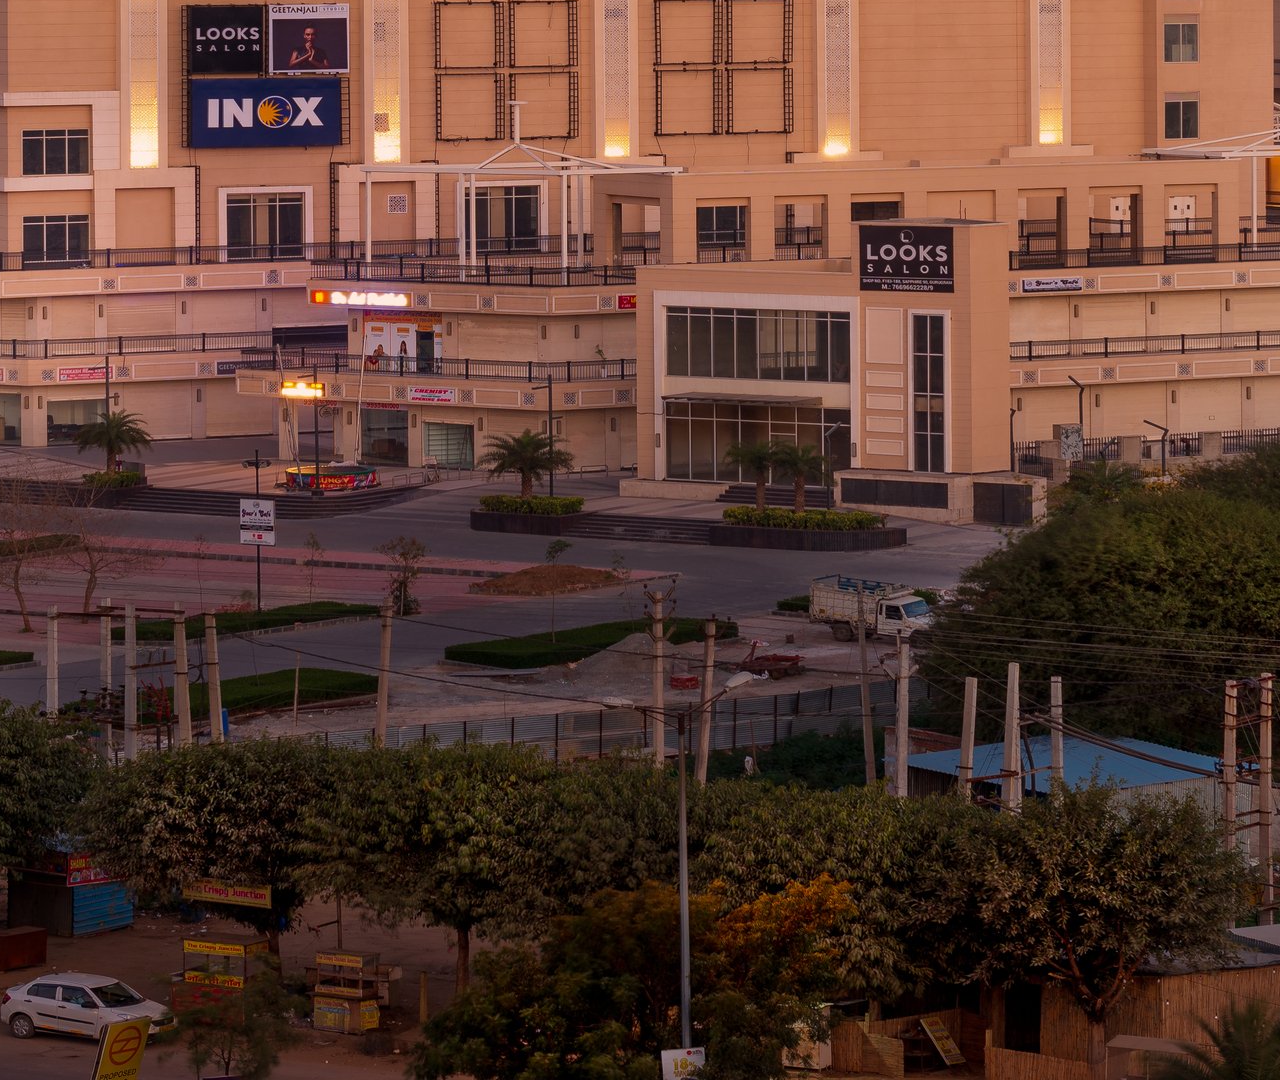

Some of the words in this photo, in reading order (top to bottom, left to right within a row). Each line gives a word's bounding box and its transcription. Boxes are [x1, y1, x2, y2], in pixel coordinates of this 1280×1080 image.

[271, 6, 318, 14] GEETANJALI
[195, 27, 260, 41] LOOKS
[196, 44, 260, 52] SALON
[207, 95, 324, 129] INOX
[866, 244, 948, 262] LOOKS
[867, 263, 948, 275] SALON
[203, 884, 229, 898] Crispy
[232, 888, 266, 900] Junction
[100, 1068, 137, 1080] PROPOSED
